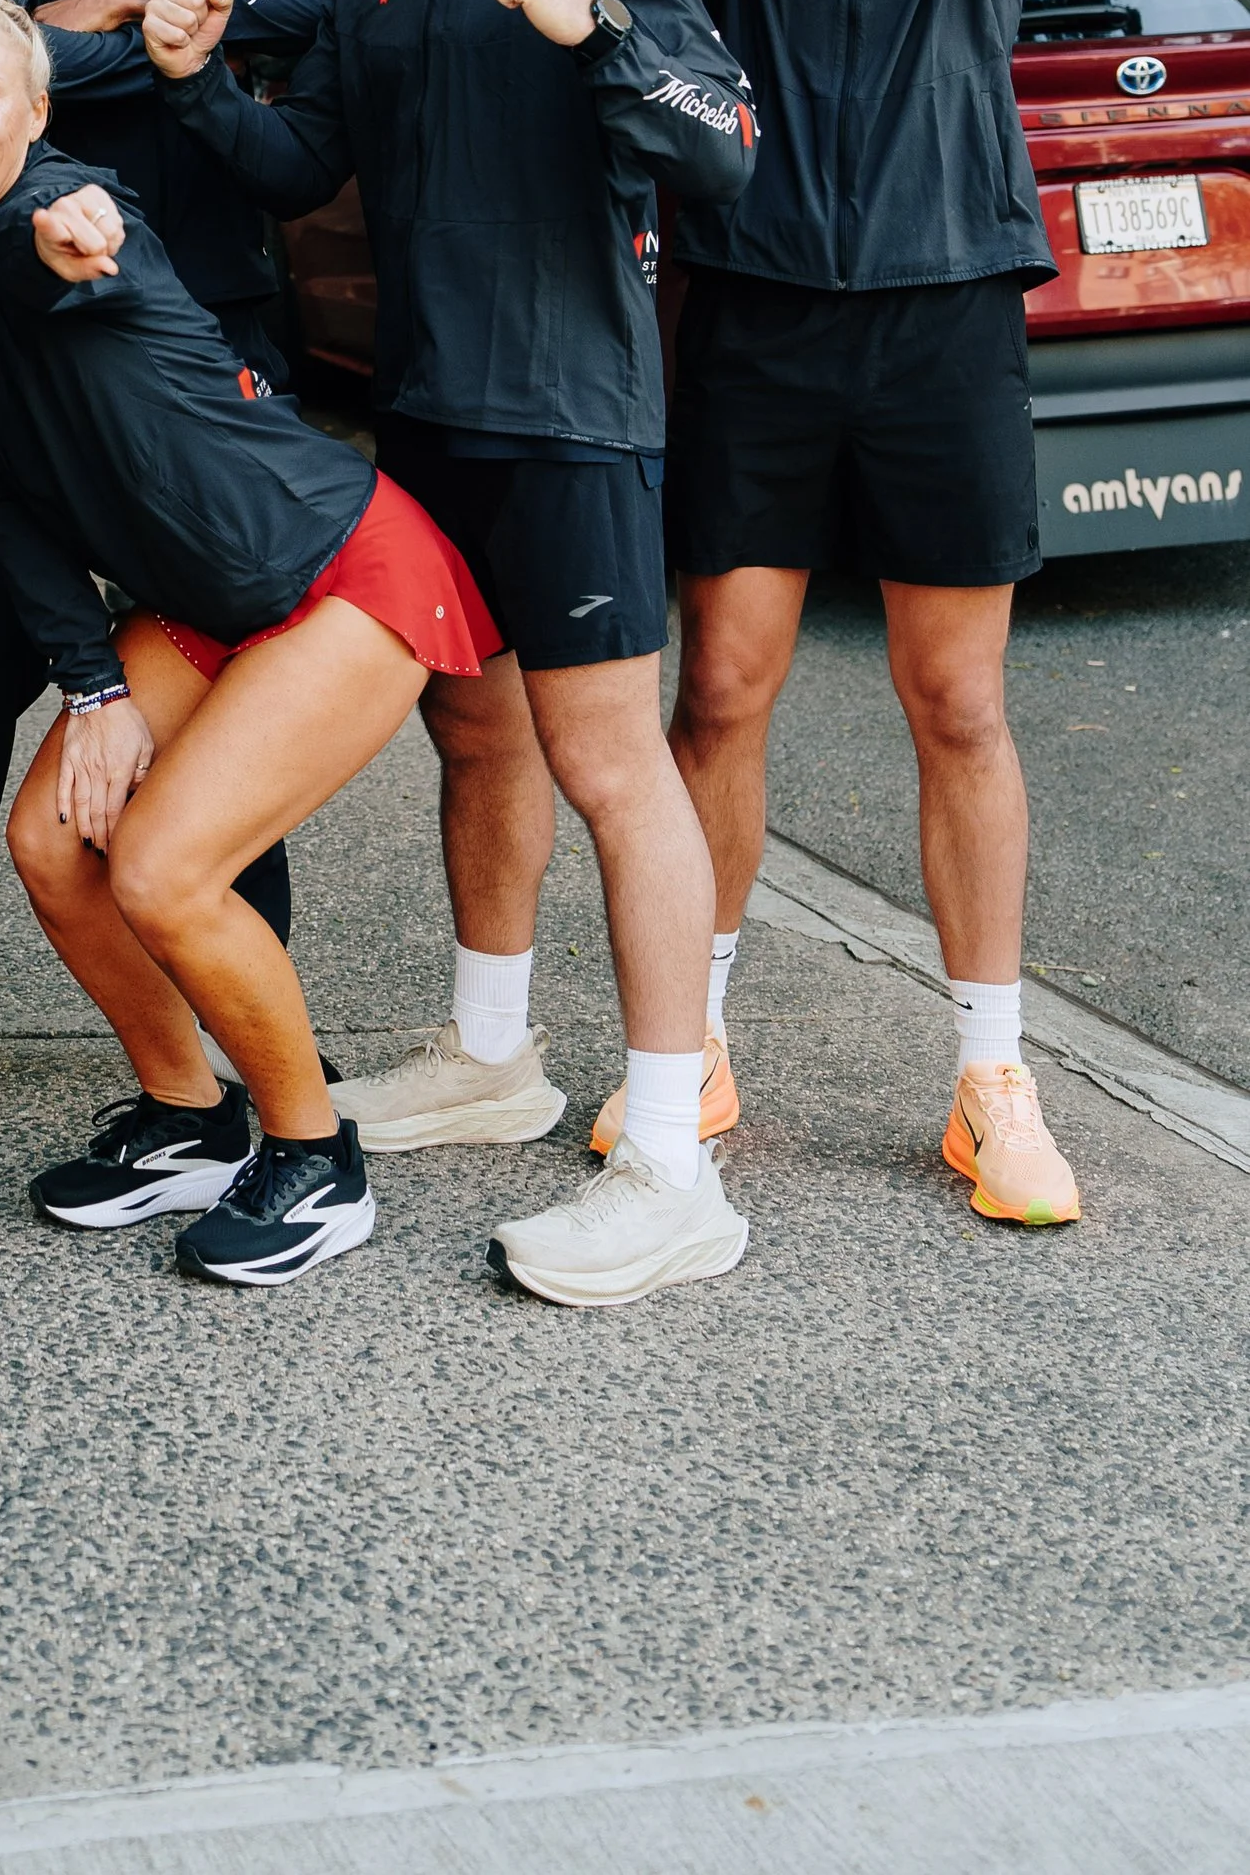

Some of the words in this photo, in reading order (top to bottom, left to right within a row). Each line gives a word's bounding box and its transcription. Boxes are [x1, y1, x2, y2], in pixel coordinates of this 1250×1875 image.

[642, 69, 739, 135] Michelob
[1039, 101, 1248, 125] SIENNA
[1088, 195, 1193, 235] T138569C
[141, 1151, 166, 1166] BROOKS
[290, 1202, 309, 1220] BROOKS
